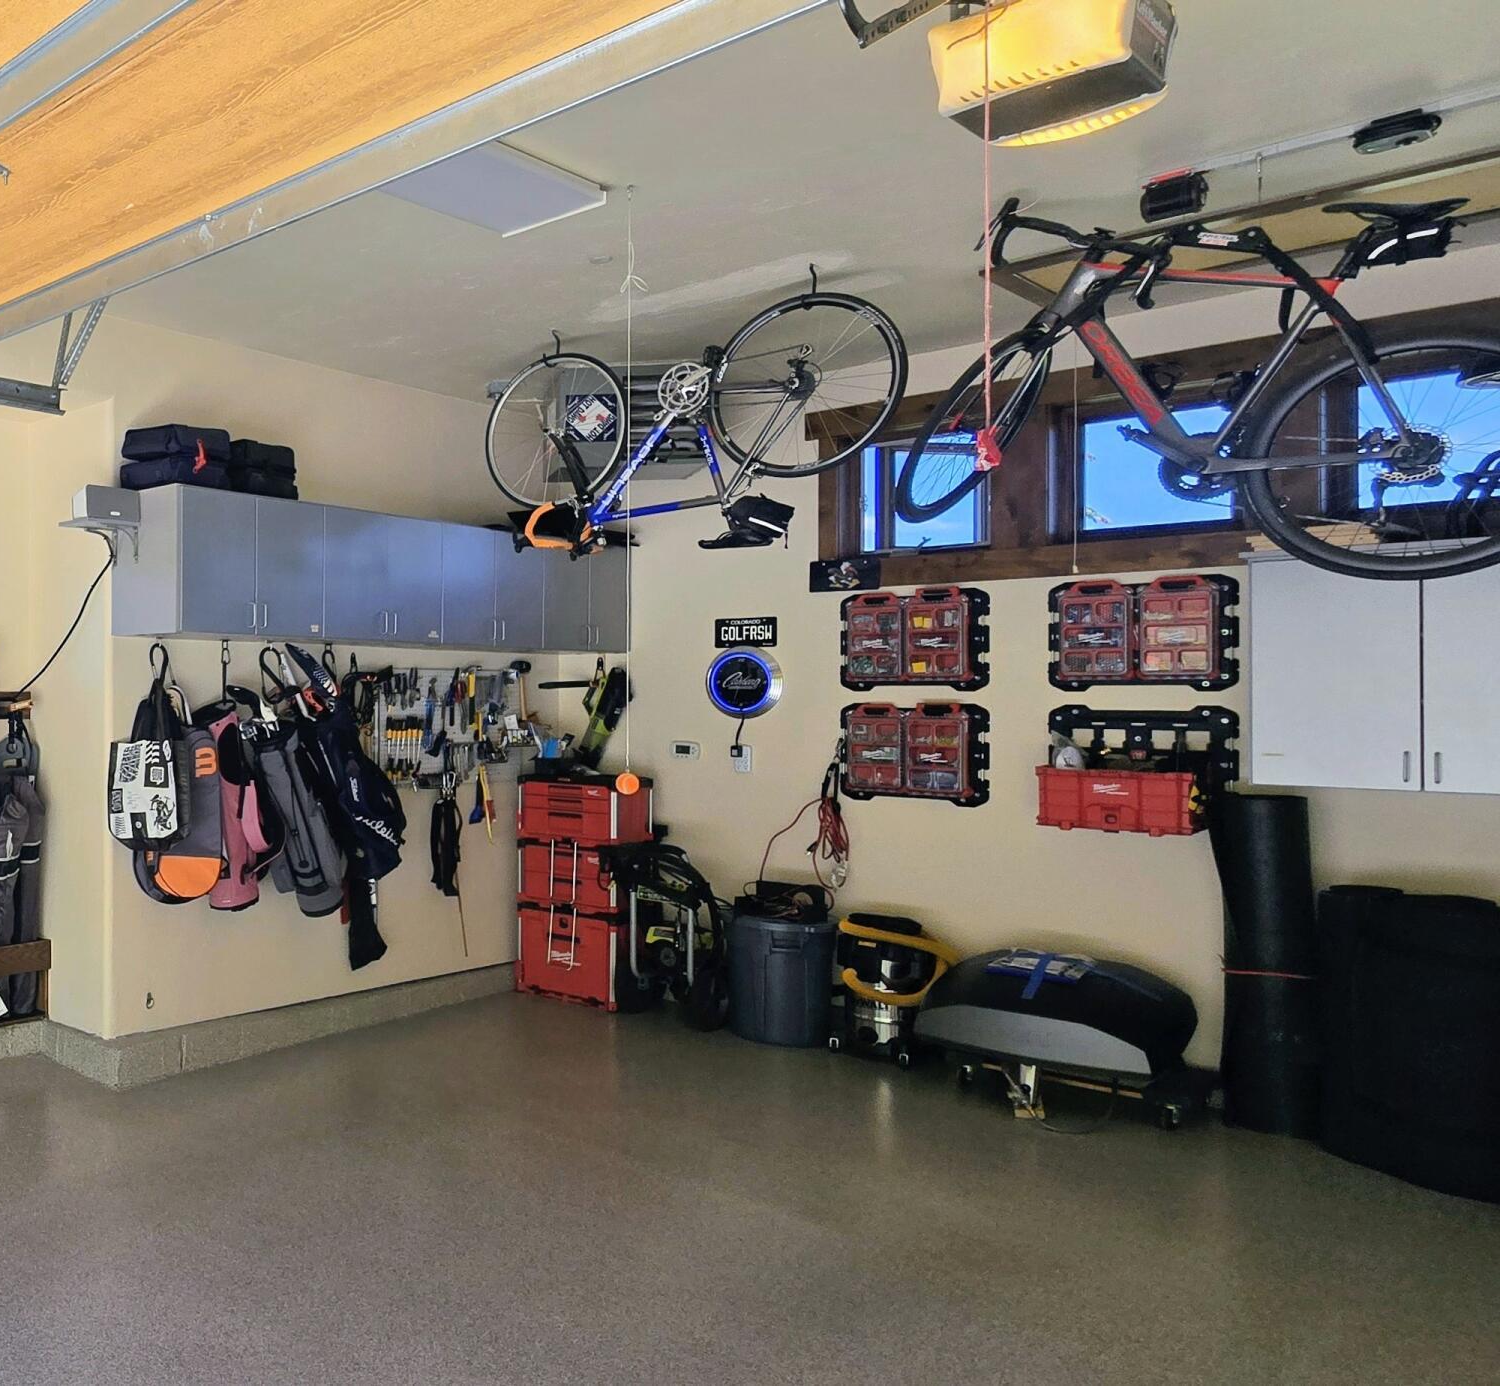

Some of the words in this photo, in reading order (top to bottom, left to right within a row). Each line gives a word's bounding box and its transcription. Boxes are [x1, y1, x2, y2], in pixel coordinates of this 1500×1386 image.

[1080, 320, 1164, 425] ORBEA
[586, 426, 600, 441] HOT
[721, 625, 773, 641] GOLFRSW
